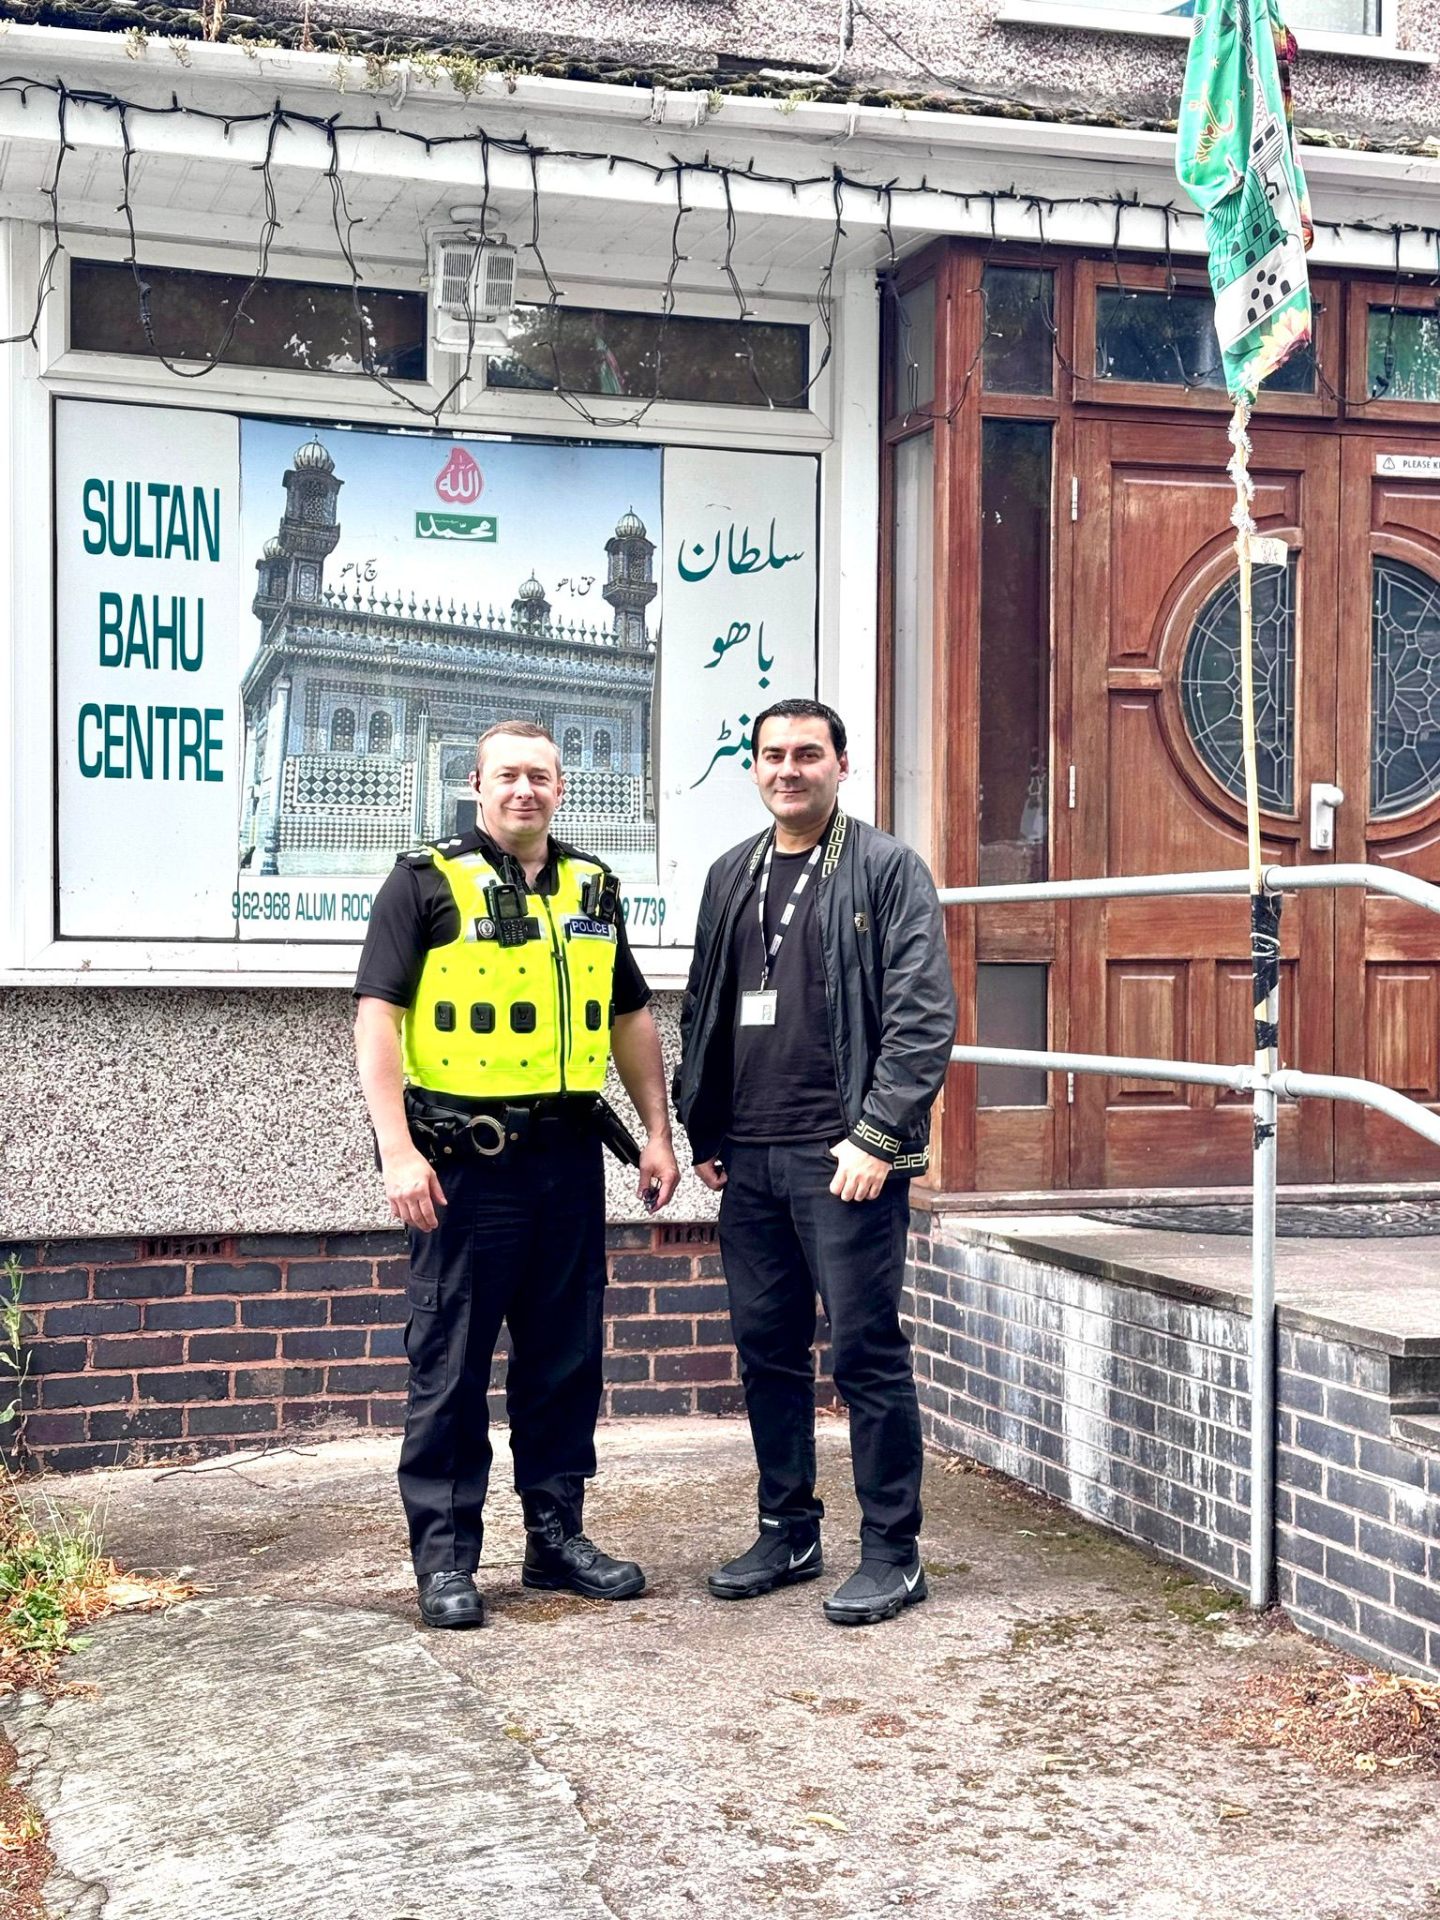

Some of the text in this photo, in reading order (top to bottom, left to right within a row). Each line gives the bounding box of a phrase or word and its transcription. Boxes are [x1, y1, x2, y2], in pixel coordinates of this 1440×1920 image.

[1402, 459, 1431, 469] PLEASE
[82, 478, 221, 563] SULTAN
[677, 517, 805, 583] سلطان
[99, 591, 204, 673] BAHU
[77, 702, 224, 783] CENTRE
[231, 891, 291, 920] 962-968
[295, 892, 336, 921] ALUM
[571, 920, 609, 934] POLICE
[633, 897, 666, 926] 7739
